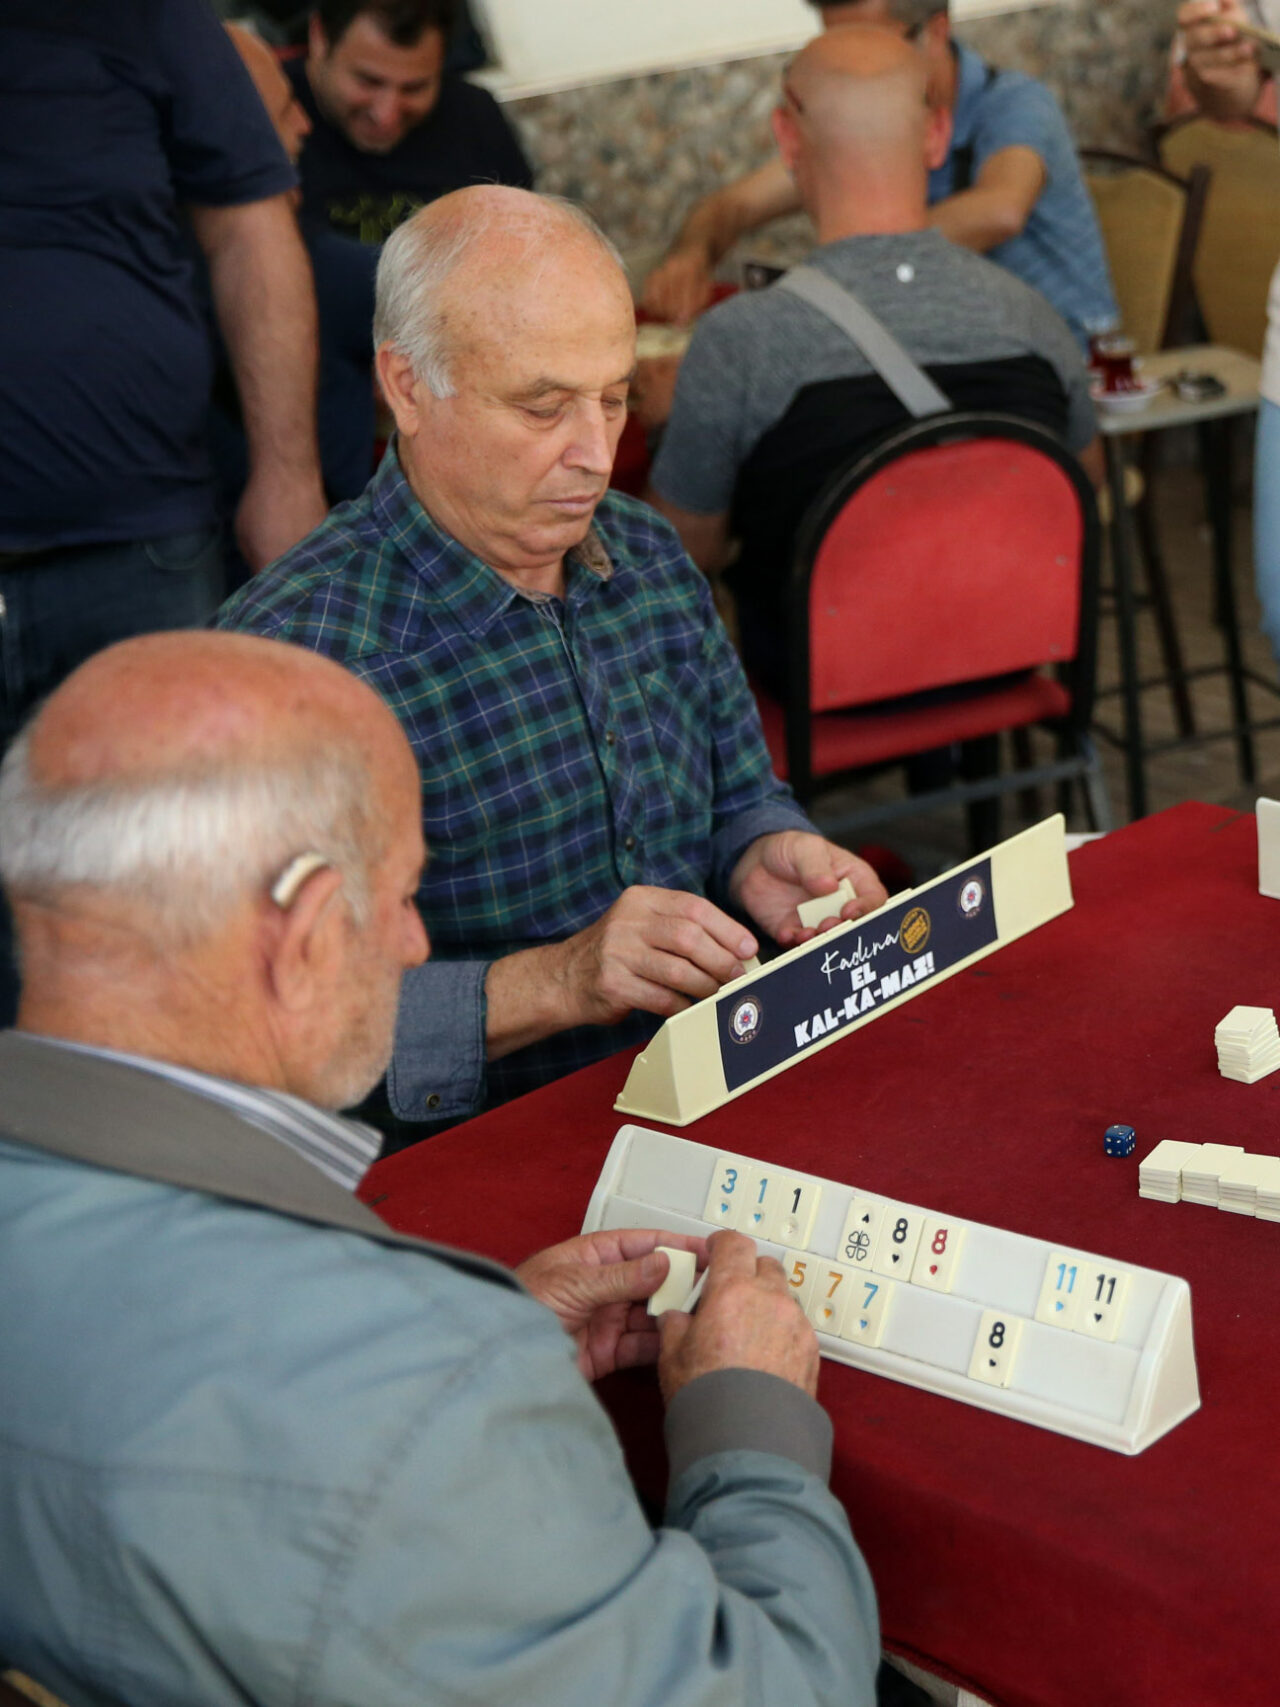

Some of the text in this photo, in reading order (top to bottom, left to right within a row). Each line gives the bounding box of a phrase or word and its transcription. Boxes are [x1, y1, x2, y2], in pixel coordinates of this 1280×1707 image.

[850, 961, 877, 992] EL
[793, 951, 936, 1048] KAL-KA-MAZ!
[720, 1168, 738, 1195] 3
[757, 1177, 769, 1204] 1
[790, 1187, 802, 1214] 1
[892, 1217, 909, 1244] 8
[930, 1228, 949, 1255] 8
[788, 1260, 807, 1288] 5
[826, 1270, 844, 1299] 7
[1055, 1262, 1078, 1294] 11
[1095, 1272, 1117, 1305] 11
[862, 1281, 880, 1310] 7
[987, 1320, 1006, 1349] 8
